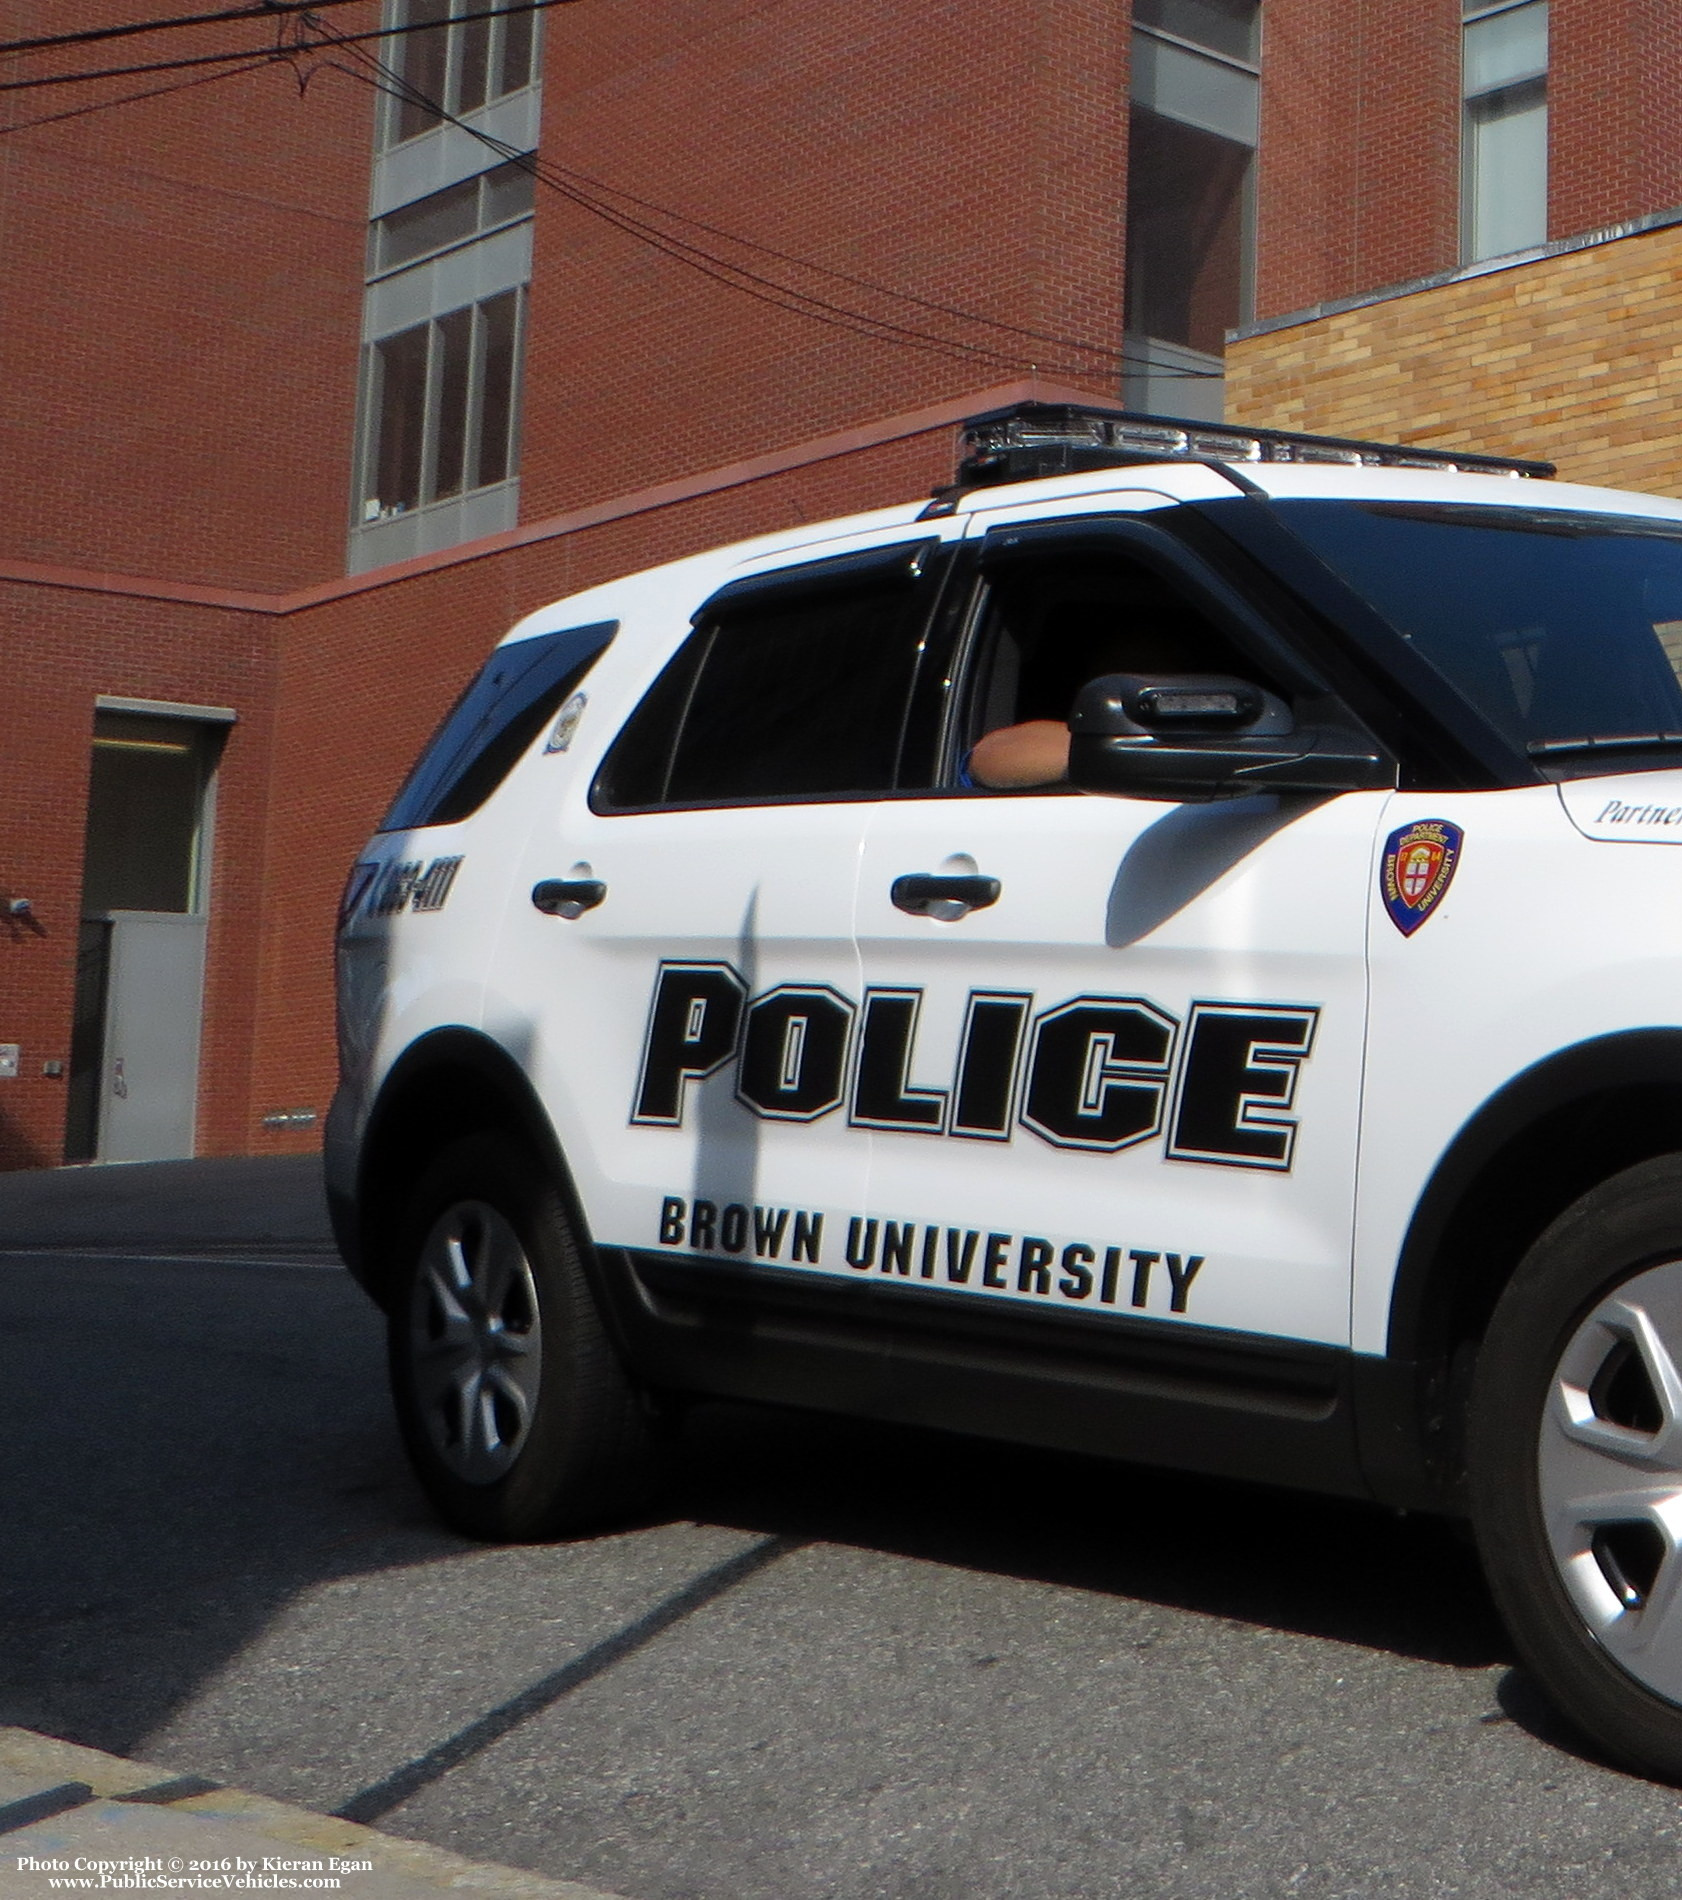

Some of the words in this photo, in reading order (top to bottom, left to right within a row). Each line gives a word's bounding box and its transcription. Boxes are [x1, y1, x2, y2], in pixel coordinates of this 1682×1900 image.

[628, 958, 1322, 1172] POLICE
[659, 1195, 824, 1265] BROWN
[846, 1218, 1206, 1314] UNIVERSITY
